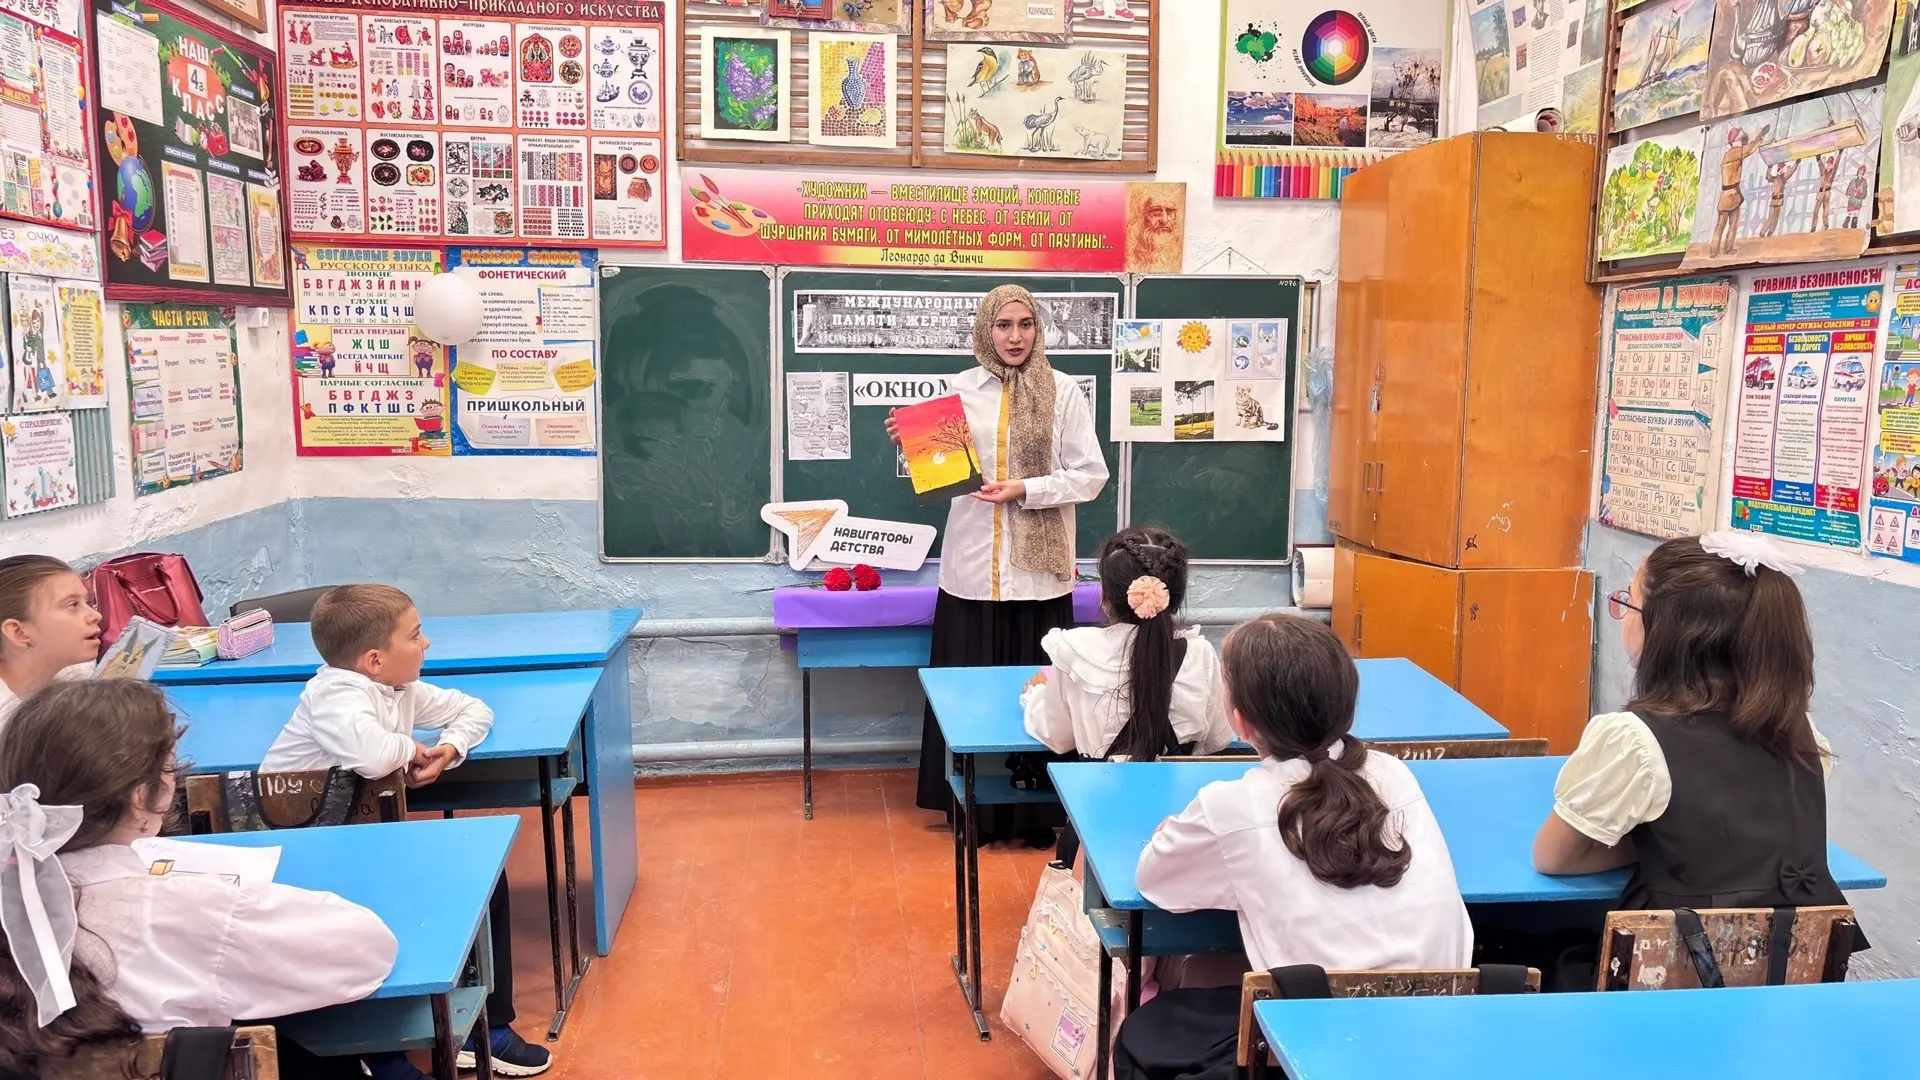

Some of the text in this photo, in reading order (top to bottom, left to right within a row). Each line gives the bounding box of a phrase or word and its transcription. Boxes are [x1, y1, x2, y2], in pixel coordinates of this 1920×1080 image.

[580, 4, 659, 20] искусства
[178, 36, 210, 66] НАШ
[891, 184, 968, 204] ВМЕСТИЛИЩЕ
[972, 184, 1022, 207] ЭМОЦИЙ,
[1028, 188, 1080, 206] КОТОРЫЕ
[804, 203, 1072, 227] ПРИХОДЯТ ОТОВСЮДУ: С НЕБЕС, ОТ ЗЕМЛИ, ОТ
[760, 224, 827, 242] ШУРШАНИЯ
[832, 226, 881, 245] БУМАГИ,
[886, 228, 899, 244] ОТ
[904, 228, 983, 246] МИМОЛЁТНЫХ
[988, 232, 1026, 248] ФОРМ,
[1030, 233, 1043, 248] ОТ
[317, 248, 432, 262] СОГЛАСНЫЕ ЗВУКИ
[462, 250, 581, 264] РАЗБОР СЛОВА
[880, 248, 984, 266] Леонардо да Винчи
[320, 262, 431, 271] РУССКОГО ЯЗЫКА
[479, 269, 566, 280] ФОНЕТИЧЕСКИЙ
[1754, 268, 1883, 292] ПРАВИЛА БЕЗОПАСНОСТИ
[304, 278, 421, 290] Б В Г Д Ж З Й Л М Н
[1618, 288, 1660, 311] ЗВУКИ
[1662, 286, 1673, 309] И
[1676, 282, 1729, 308] БУКВЫ
[152, 310, 209, 326] ЧАСТИ РЕЧИ
[309, 305, 414, 318] К П С Т Ф Х Ц Ч Ш
[832, 314, 897, 326] ПАМЯТИ
[906, 315, 958, 327] ЖЕРТВ
[1754, 323, 1776, 331] ЕДИНЫЙ
[1777, 322, 1795, 331] НОМЕР
[1797, 321, 1822, 330] СЛУЖБЫ
[1824, 320, 1855, 328] СПАСЕНИЯ
[1620, 333, 1643, 341] ГЛАСНЫЕ
[1666, 332, 1683, 340] ЗВУКИ
[352, 339, 389, 351] Ж Ц Ш
[1802, 343, 1821, 352] ДОРОГЕ
[492, 350, 558, 359] ПО СОСТАВУ
[355, 360, 389, 374] Й Ч Щ
[329, 390, 413, 402] Б В Г Д Ж З
[854, 381, 934, 398] «ОКНО
[329, 404, 415, 413] П Ф К Т Ш С
[467, 399, 585, 411] ПРИШКОЛЬНЫЙ
[1618, 414, 1647, 424] СОГЛАСНЫЕ
[1674, 418, 1694, 427] ЗВУКИ
[834, 527, 914, 545] НАВИГАТОРЫ
[830, 541, 885, 555] ДЕТСТВА
